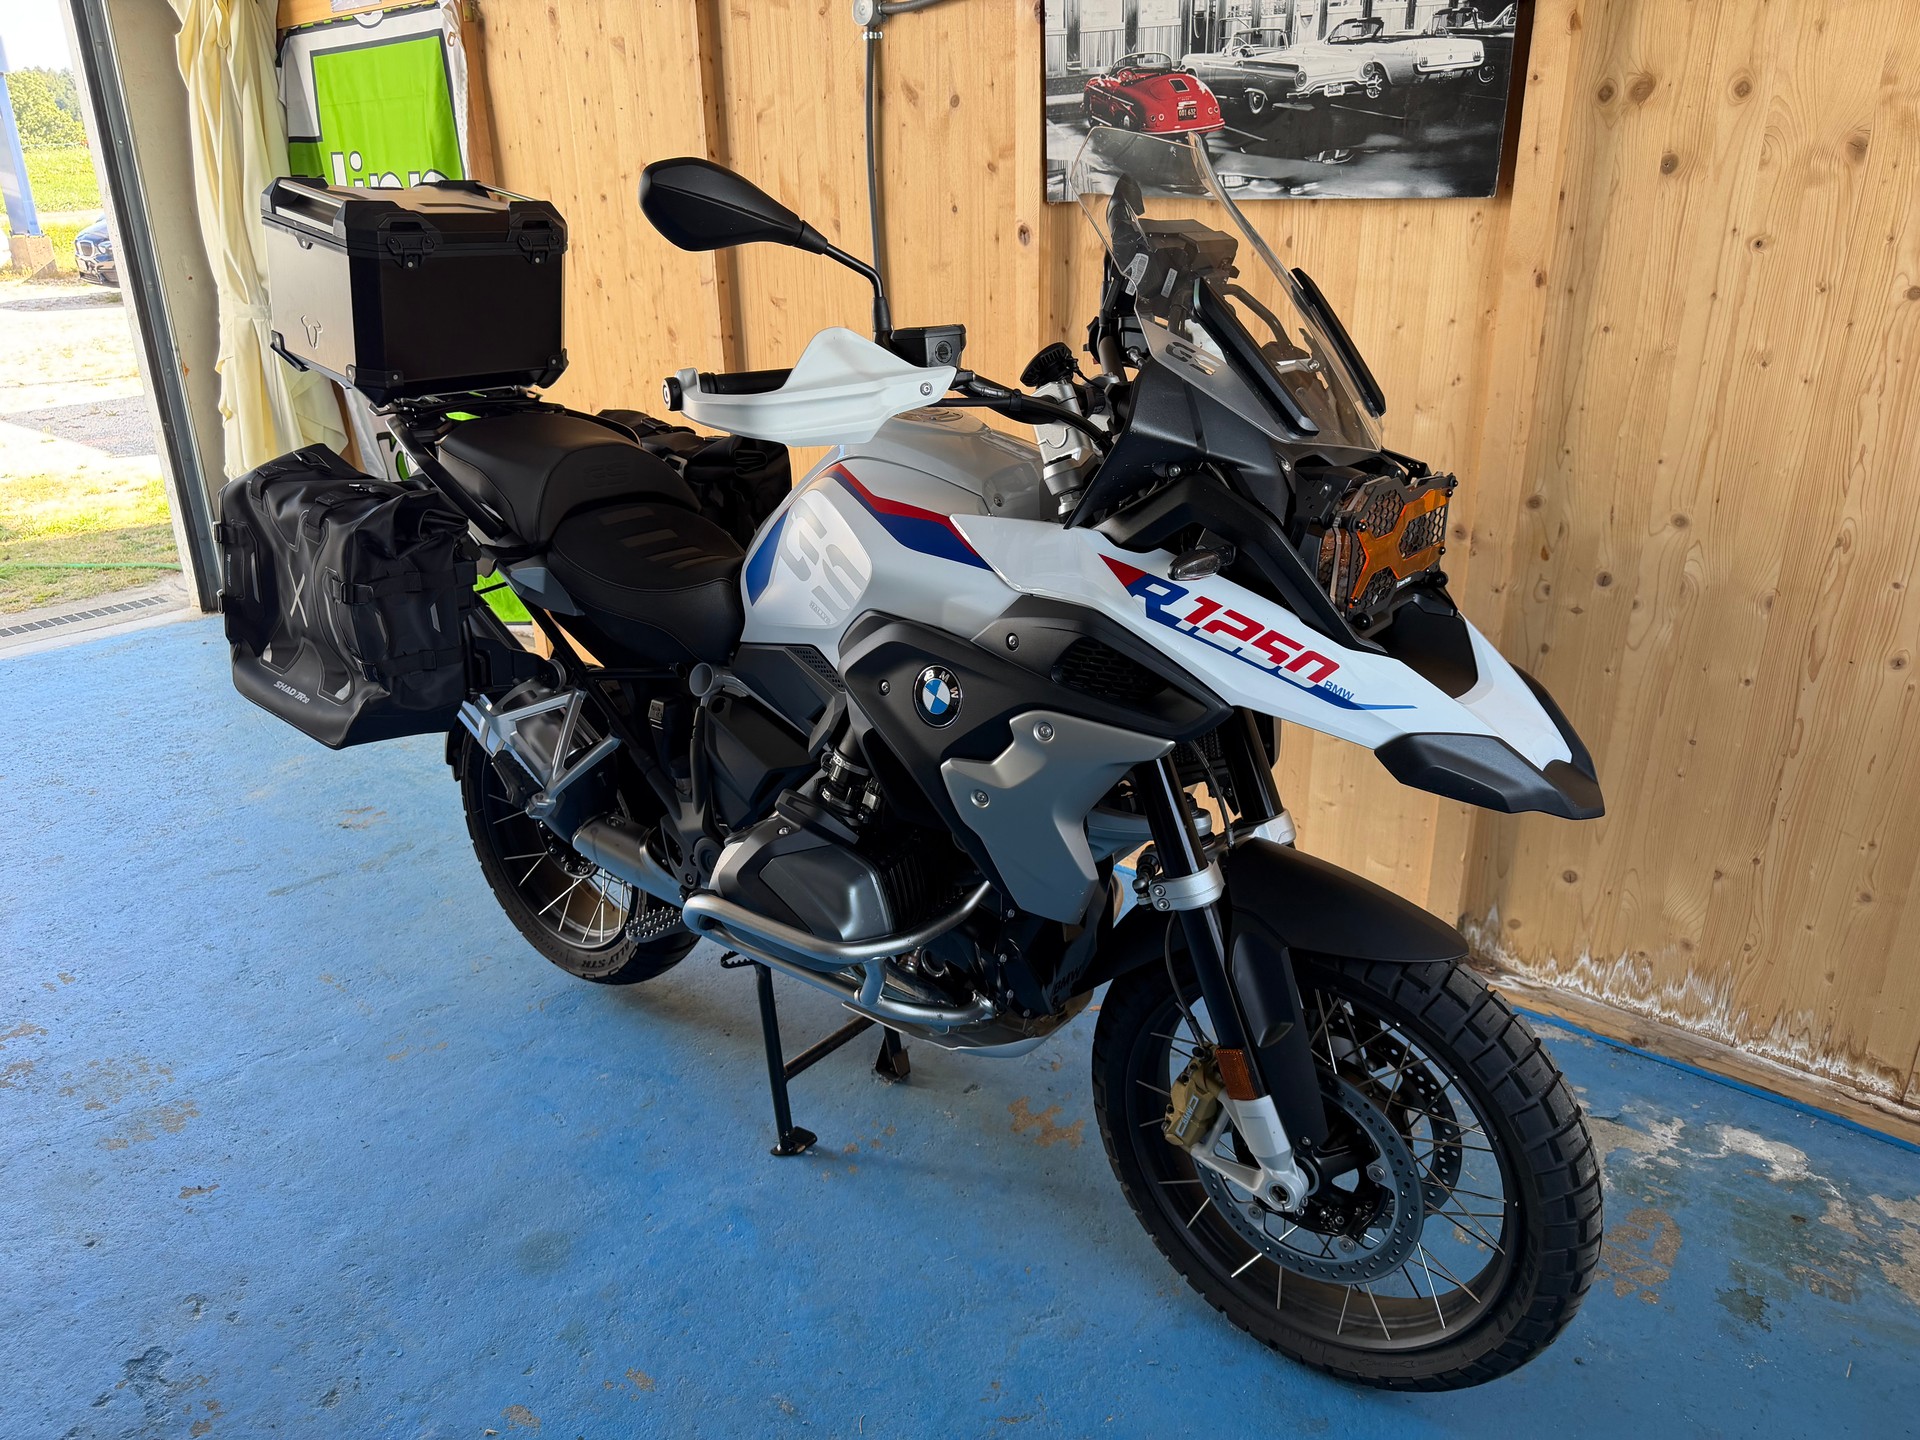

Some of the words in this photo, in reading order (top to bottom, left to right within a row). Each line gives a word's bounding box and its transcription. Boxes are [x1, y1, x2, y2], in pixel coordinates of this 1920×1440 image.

[1165, 341, 1221, 376] GS
[1126, 573, 1190, 625] R
[1176, 595, 1340, 688] 1250
[273, 680, 297, 696] SHAD
[923, 669, 959, 699] BMW
[1323, 680, 1354, 700] BMW
